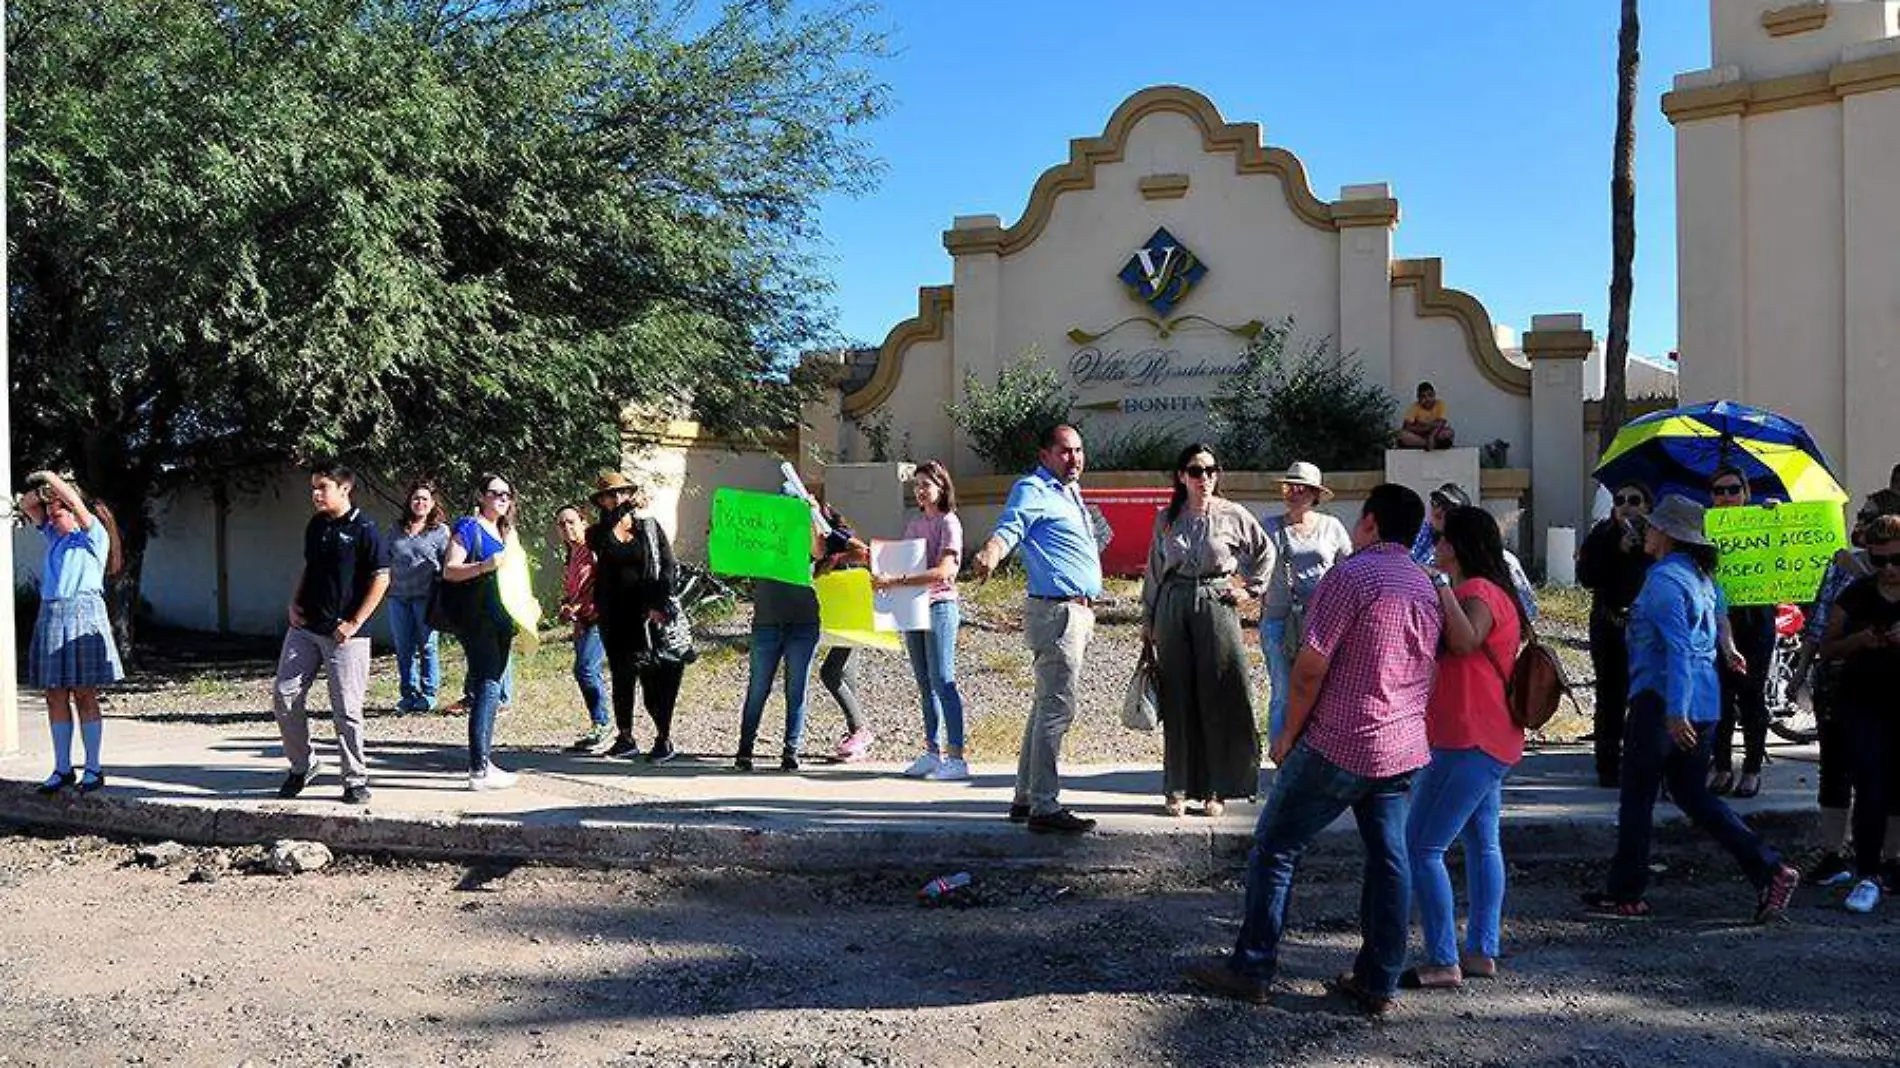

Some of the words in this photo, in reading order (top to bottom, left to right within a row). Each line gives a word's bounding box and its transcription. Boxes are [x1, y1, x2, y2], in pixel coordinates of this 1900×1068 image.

[1068, 347, 1125, 388] Villa
[1124, 396, 1204, 414] BONITA
[1780, 529, 1836, 547] ACCESO
[1775, 556, 1804, 573] RIO
